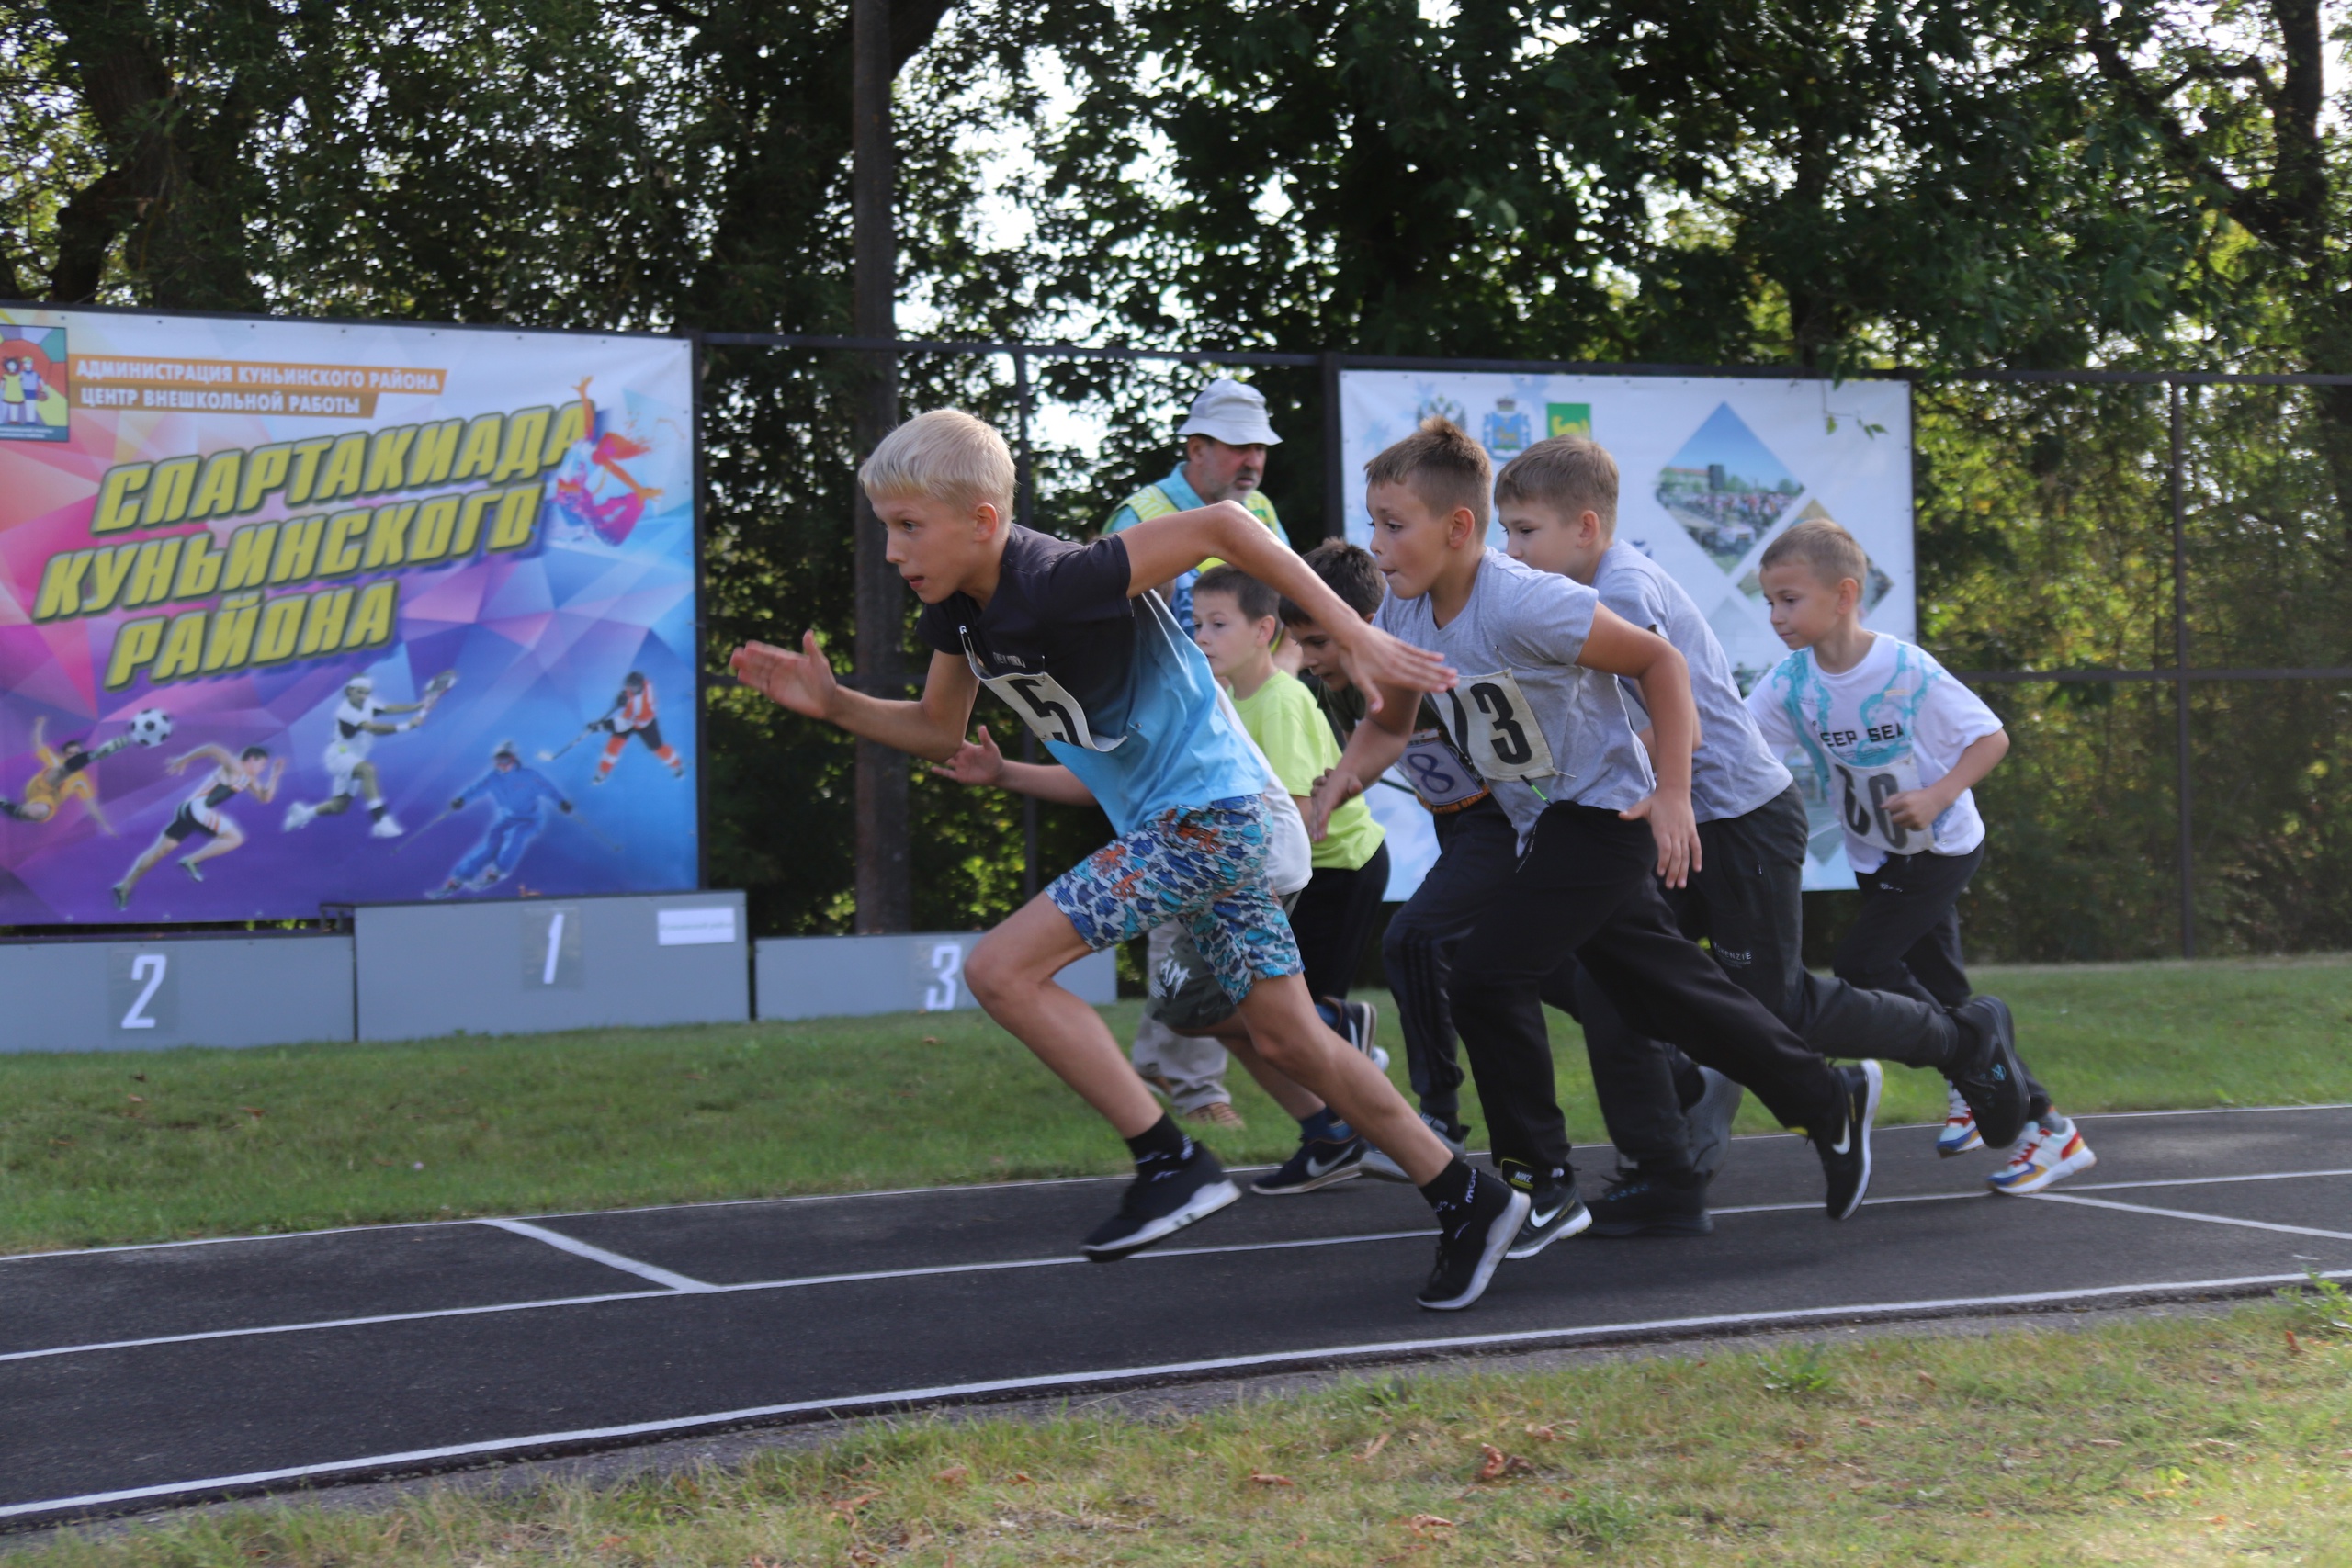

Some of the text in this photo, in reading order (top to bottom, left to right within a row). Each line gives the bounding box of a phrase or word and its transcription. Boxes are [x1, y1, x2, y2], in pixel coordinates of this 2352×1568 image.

[76, 359, 440, 390] АДМИНИСТРАЦИЯ КУНЬИНСКОГО РАЙОНА
[81, 387, 360, 413] ЦЕНТР ВНЕШКОЛЬНОЙ РАБОТЫ
[89, 400, 594, 536] СПАРТАКИАДА
[31, 481, 546, 624] КУНЬИНСКОГО
[103, 578, 399, 691] РАЙОНА
[1007, 678, 1085, 748] 5
[1407, 753, 1455, 794] 8
[543, 912, 565, 985] 1
[925, 944, 962, 1012] 3
[120, 953, 167, 1029] 2
[1514, 1171, 1533, 1184] NIKE
